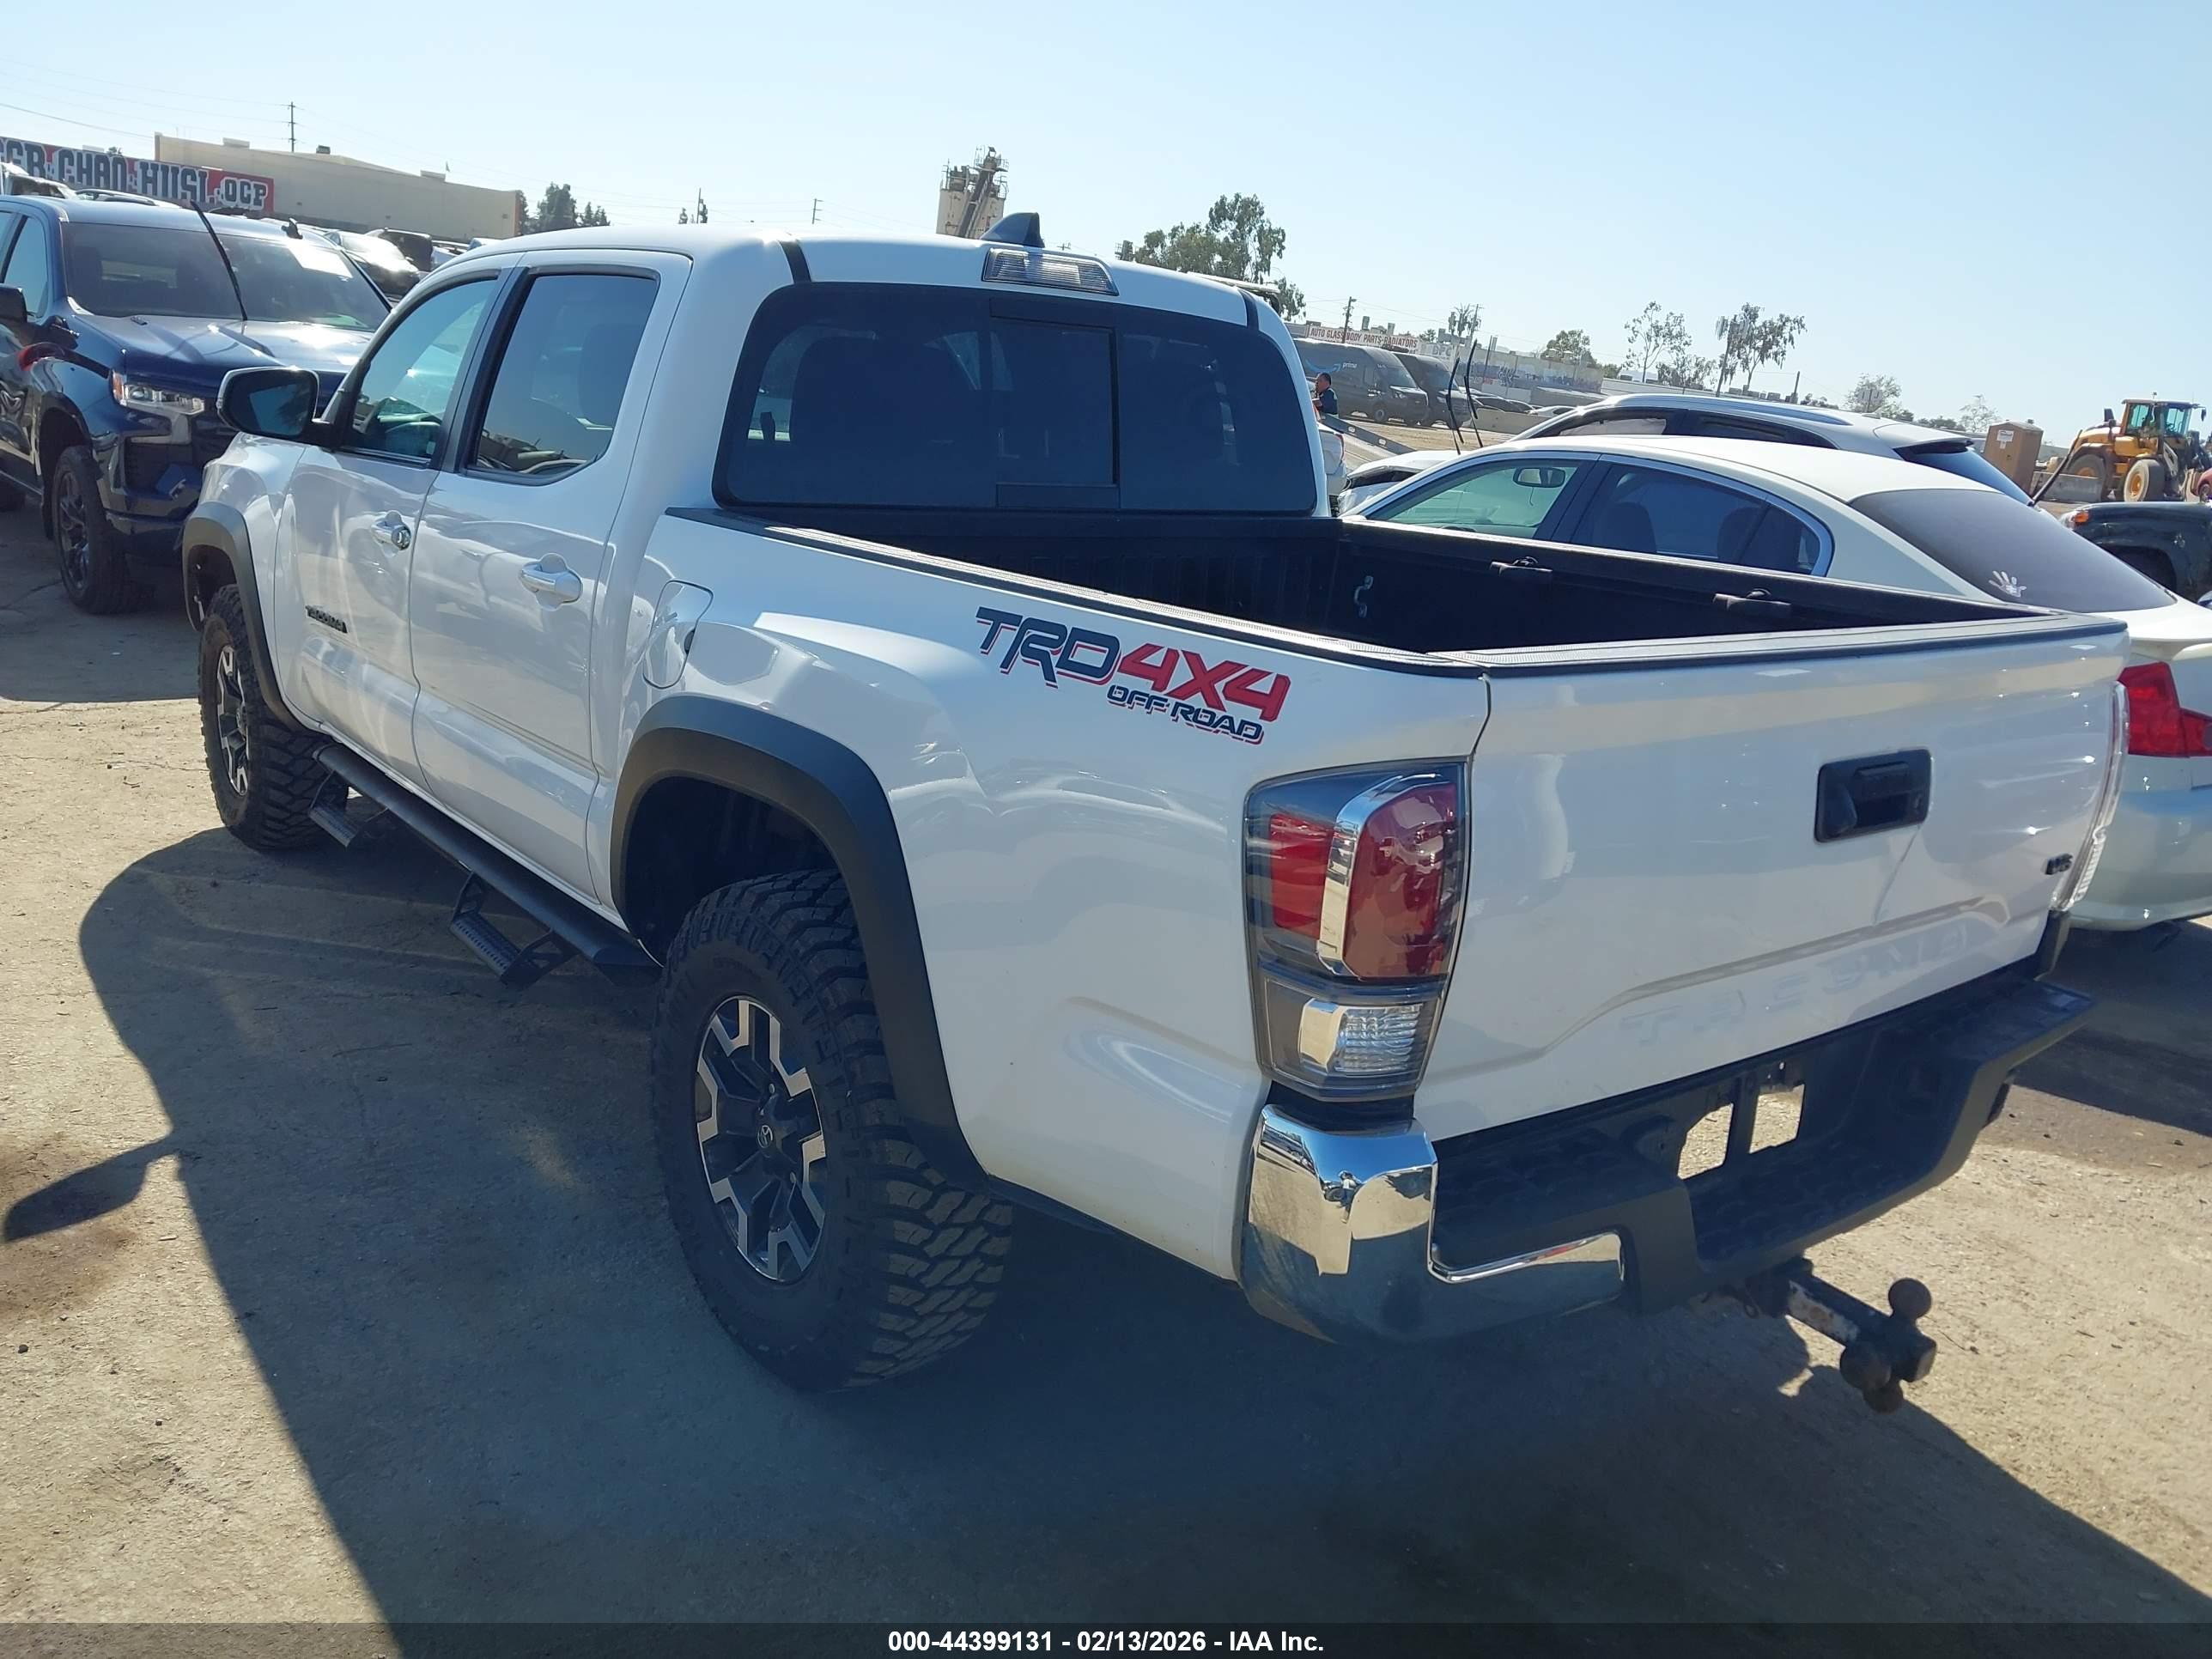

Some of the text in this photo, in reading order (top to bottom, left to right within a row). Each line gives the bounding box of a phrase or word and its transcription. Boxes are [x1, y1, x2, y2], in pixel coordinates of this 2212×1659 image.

[1310, 328, 1325, 337] AUTO
[975, 606, 1121, 689] TRD
[1107, 684, 1265, 744] OFF ROAD
